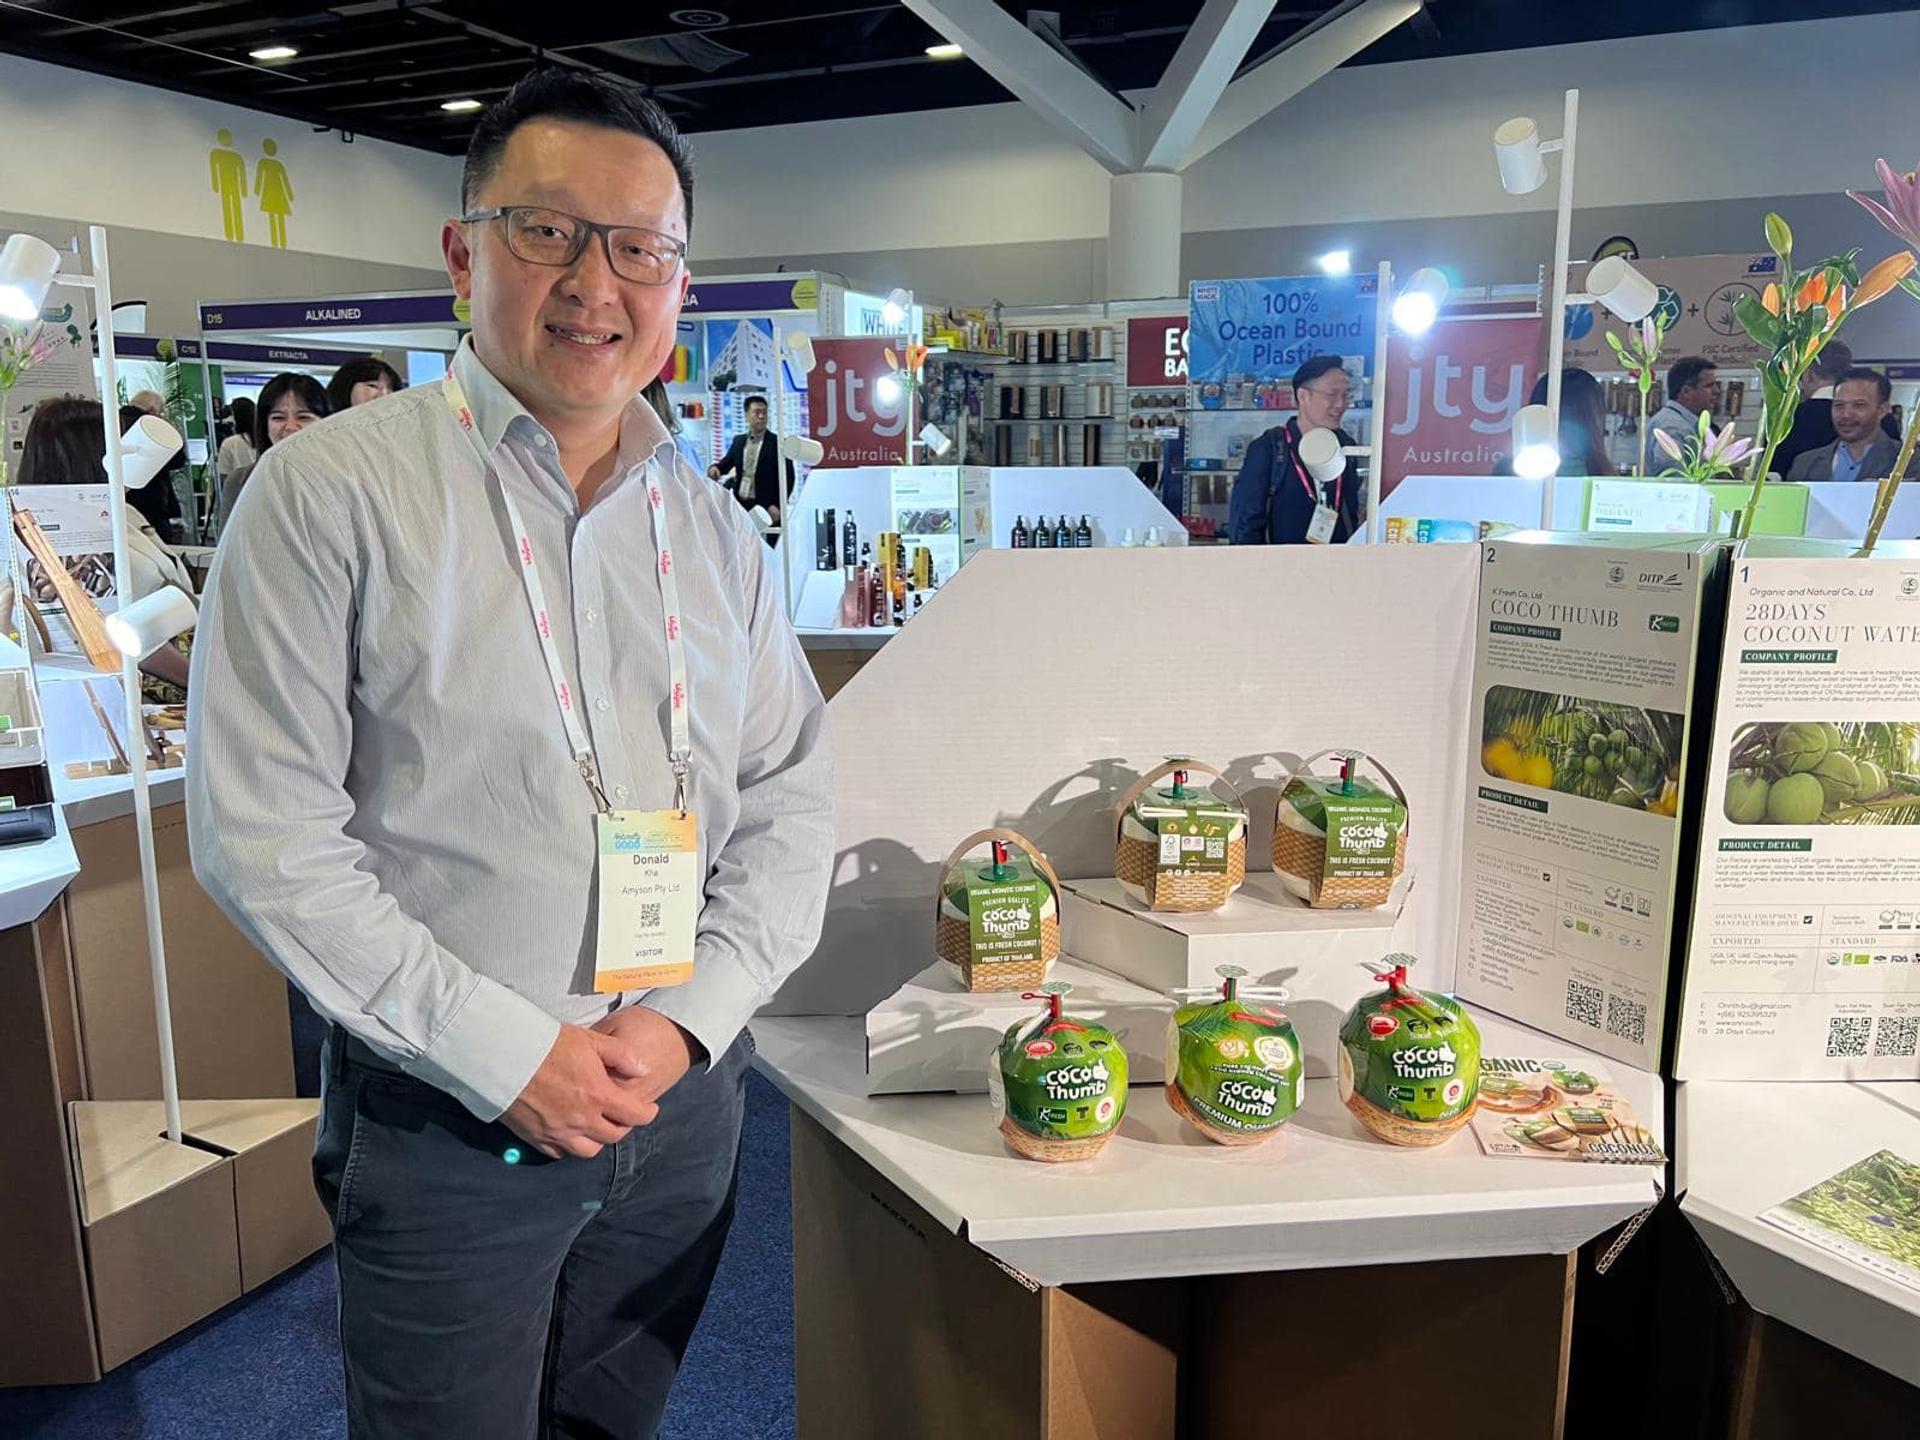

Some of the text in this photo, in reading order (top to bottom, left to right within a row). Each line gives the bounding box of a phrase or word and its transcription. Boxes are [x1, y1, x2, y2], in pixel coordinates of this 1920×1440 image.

[1263, 292, 1319, 315] 100%
[206, 314, 223, 325] D15
[305, 308, 362, 321] ALKALINED
[1219, 316, 1361, 341] Ocean Bound
[1165, 327, 1190, 356] E
[1253, 343, 1325, 366] Plasti
[828, 446, 900, 462] Australia
[1486, 548, 1496, 563] 2
[1639, 573, 1664, 584] DITP
[1740, 566, 1750, 583] 1
[1750, 588, 1785, 597] Organic
[1787, 587, 1806, 596] and
[1806, 588, 1840, 596] Natural
[1858, 588, 1874, 596] Ltd
[1490, 599, 1619, 628] COCO THUMB
[1746, 604, 1827, 620] 28DAYS
[1492, 624, 1560, 639] COMPANY PROFILE
[1743, 626, 1855, 643] COCONUT
[1744, 652, 1833, 661] COMPANY PROFILE
[1481, 789, 1539, 809] PRODUCT DETAIL
[1340, 837, 1386, 849] Thumb
[1723, 842, 1800, 850] PRODUCT DETAIL
[633, 854, 670, 866] Donald
[982, 919, 1030, 934] Thumb
[976, 940, 1036, 950] THIS IS FRESH COCONUT
[635, 948, 664, 958] VISITOR
[982, 955, 1003, 963] PRODUCT
[1726, 1028, 1744, 1036] Days
[1394, 1063, 1454, 1079] Thumb
[1480, 1058, 1541, 1072] GANIC
[1046, 1080, 1106, 1100] Thumb
[1218, 1091, 1272, 1116] Thumb
[1194, 1097, 1242, 1129] PREMIUM
